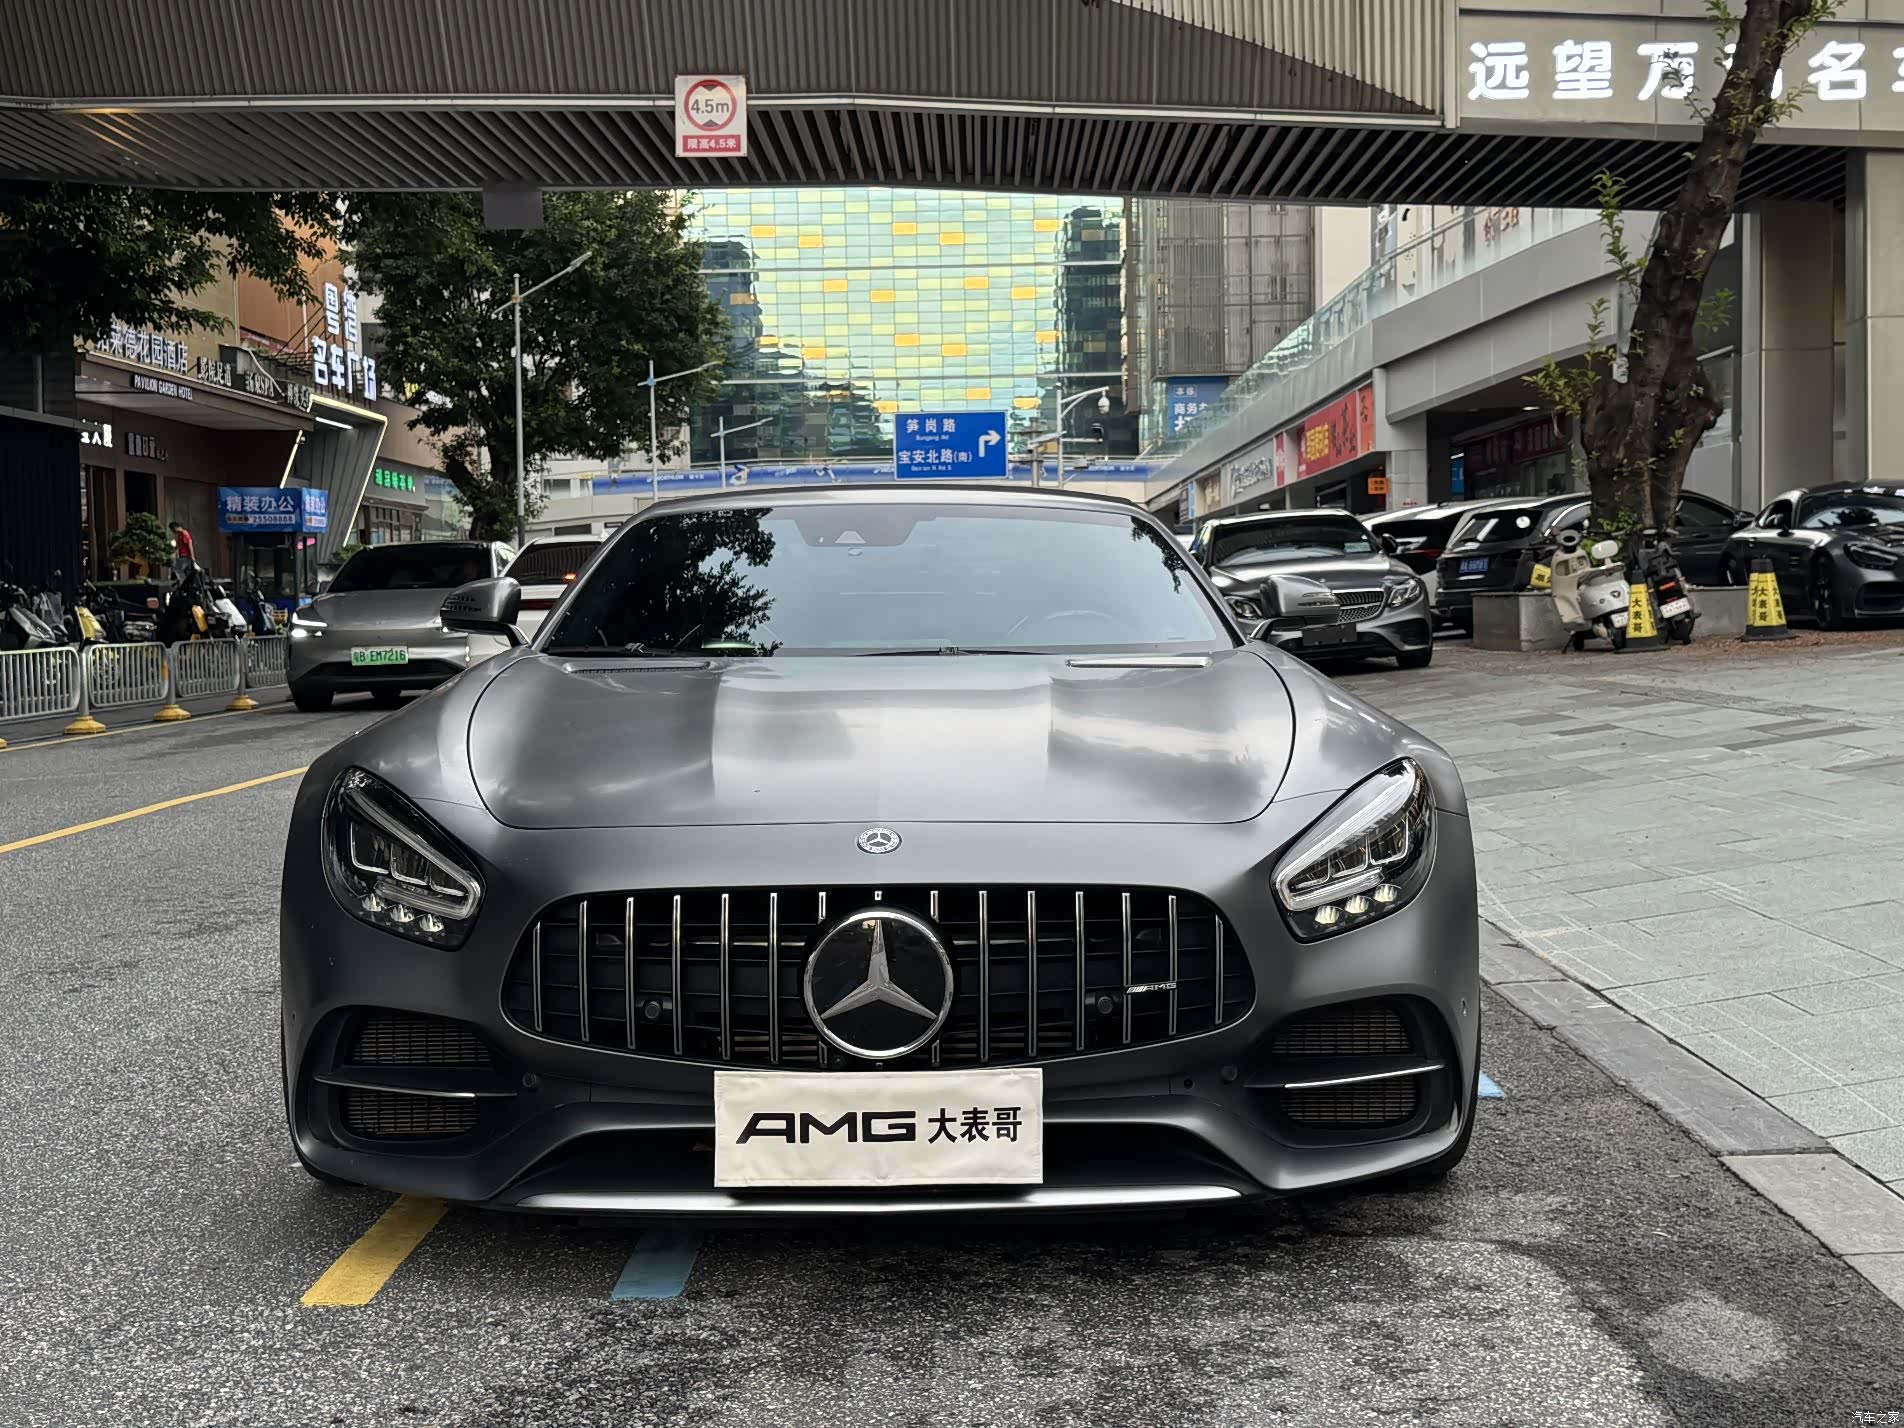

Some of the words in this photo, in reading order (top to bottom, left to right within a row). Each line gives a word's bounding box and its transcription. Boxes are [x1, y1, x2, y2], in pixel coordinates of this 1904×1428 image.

[1467, 39, 1904, 100] 远望万名
[690, 98, 730, 114] 4.5m
[687, 138, 737, 149] 限高4.5米
[311, 335, 377, 402] 名车广场
[134, 374, 158, 393] PAVILION
[158, 380, 178, 397] GARDEN
[178, 386, 193, 400] HOTEL
[905, 418, 956, 433] 笋岗路
[898, 448, 973, 464] 宝安北路(南)
[226, 495, 294, 512] 精装办公
[1758, 586, 1768, 622] 大表哥
[1631, 597, 1642, 633] 大表哥
[1142, 982, 1177, 993] AMG
[735, 1111, 916, 1144] AMG
[928, 1107, 1022, 1144] 大表哥
